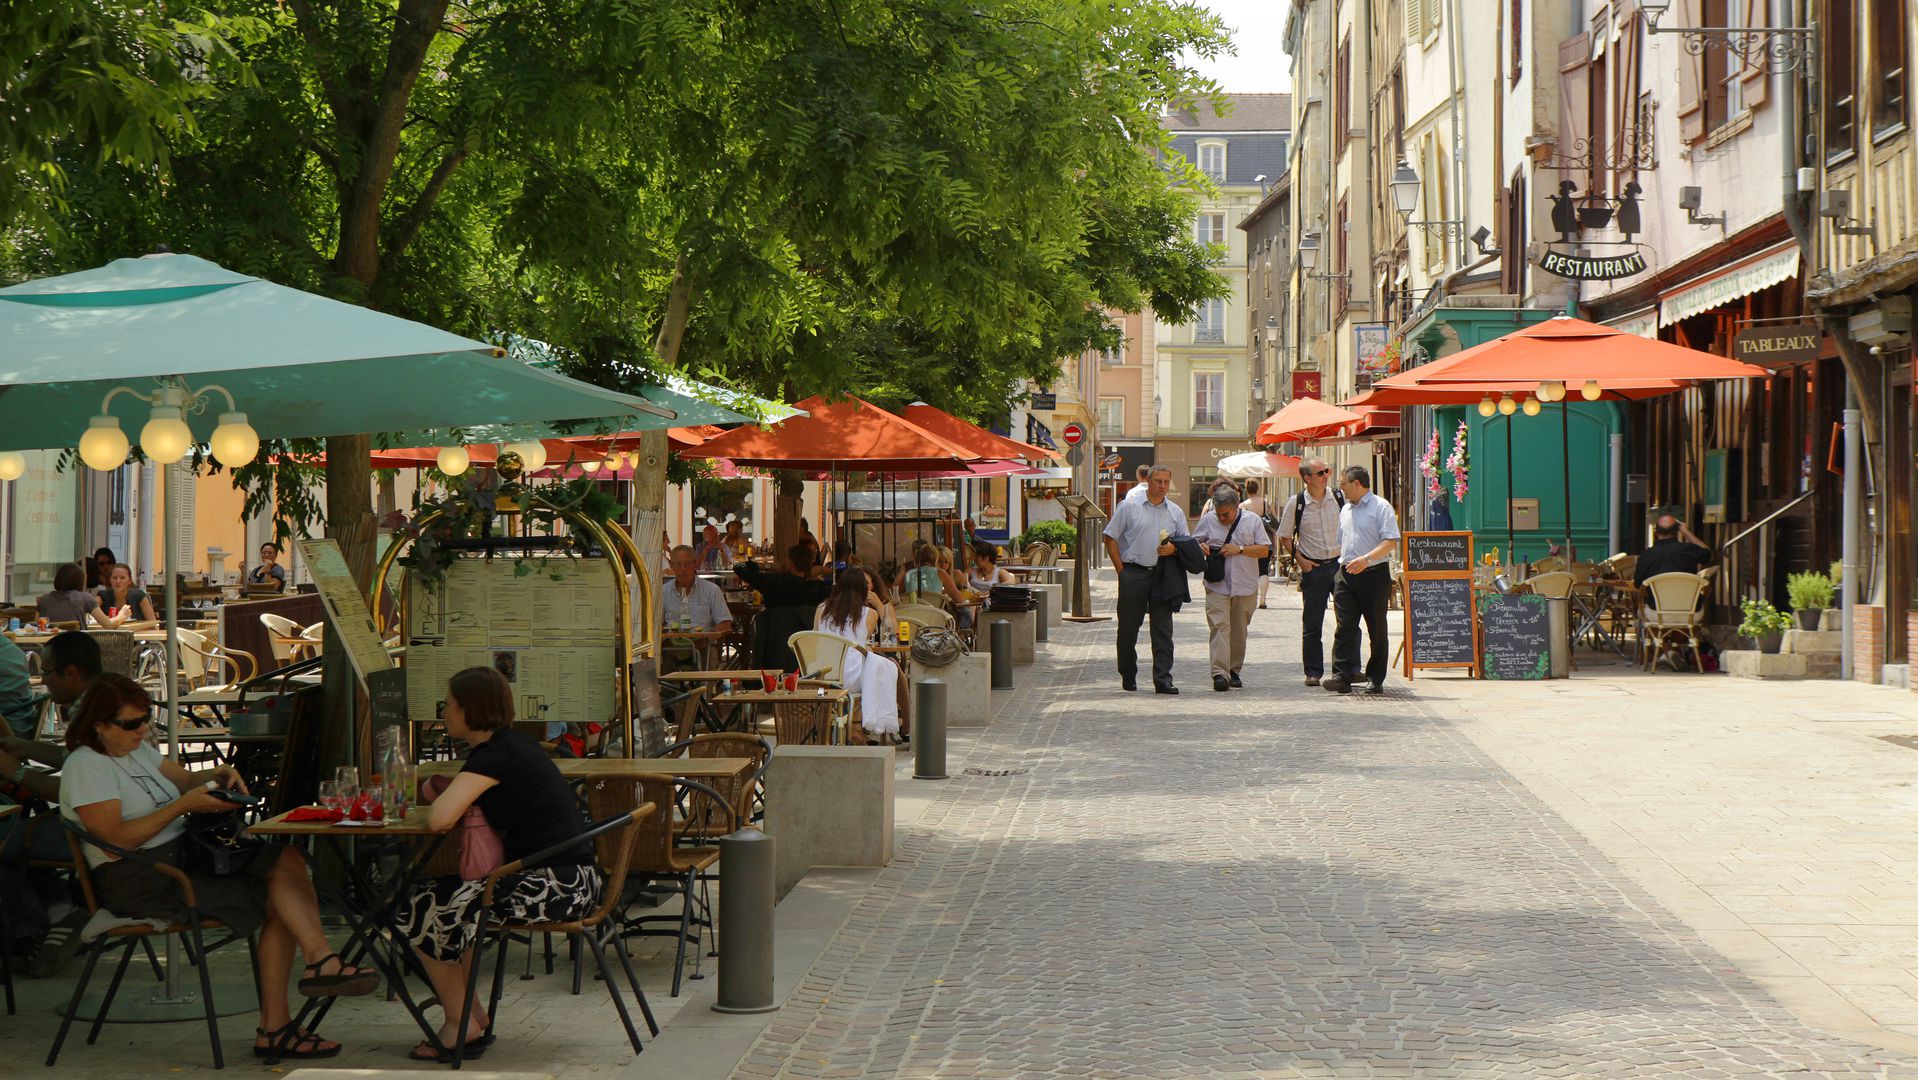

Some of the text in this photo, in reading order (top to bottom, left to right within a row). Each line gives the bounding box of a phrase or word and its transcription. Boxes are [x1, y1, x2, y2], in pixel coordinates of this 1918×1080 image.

[1544, 253, 1643, 278] RESTAURANT
[1740, 335, 1816, 353] TABLEAUX
[1408, 538, 1464, 549] Restaurant
